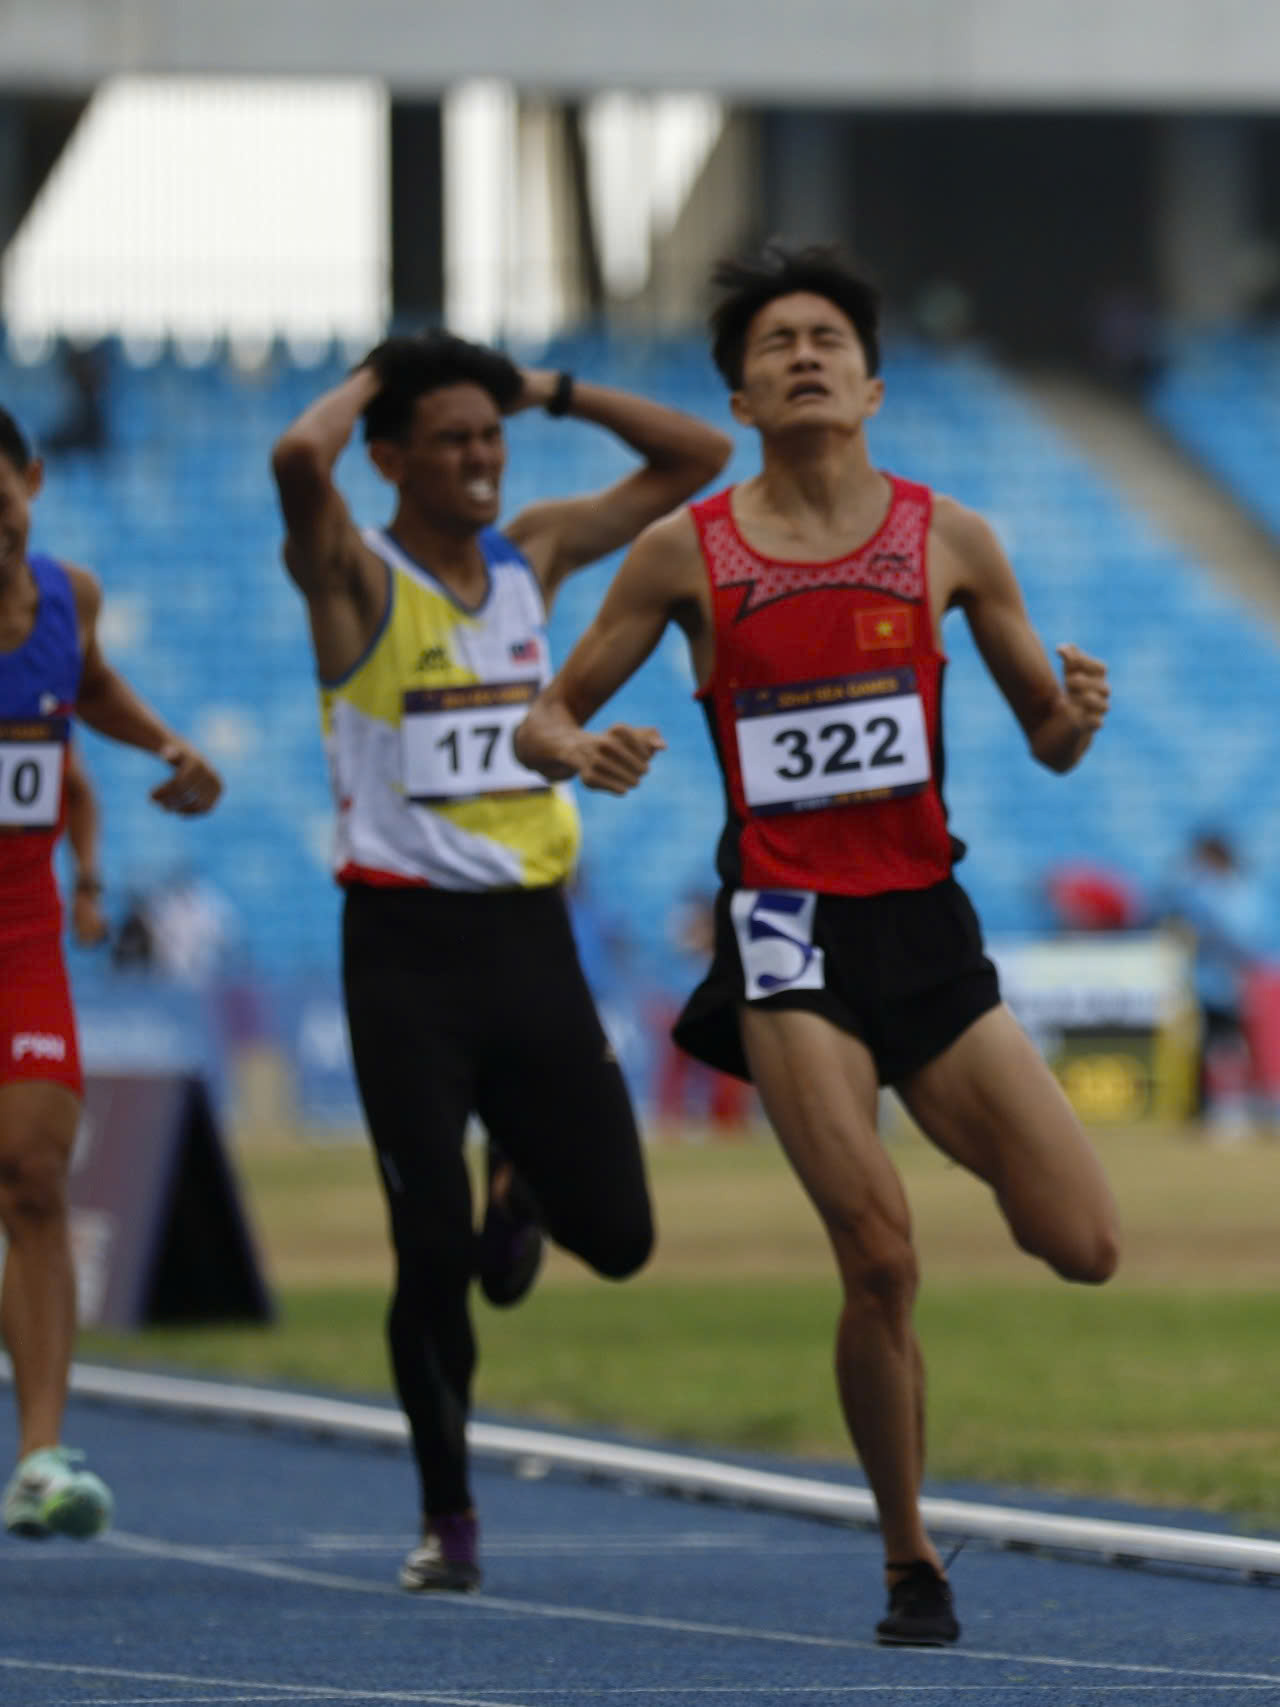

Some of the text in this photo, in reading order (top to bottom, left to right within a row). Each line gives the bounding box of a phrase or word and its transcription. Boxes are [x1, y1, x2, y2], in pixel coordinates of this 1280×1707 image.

[436, 725, 519, 774] 17
[773, 716, 905, 782] 322
[0, 757, 41, 807] 0
